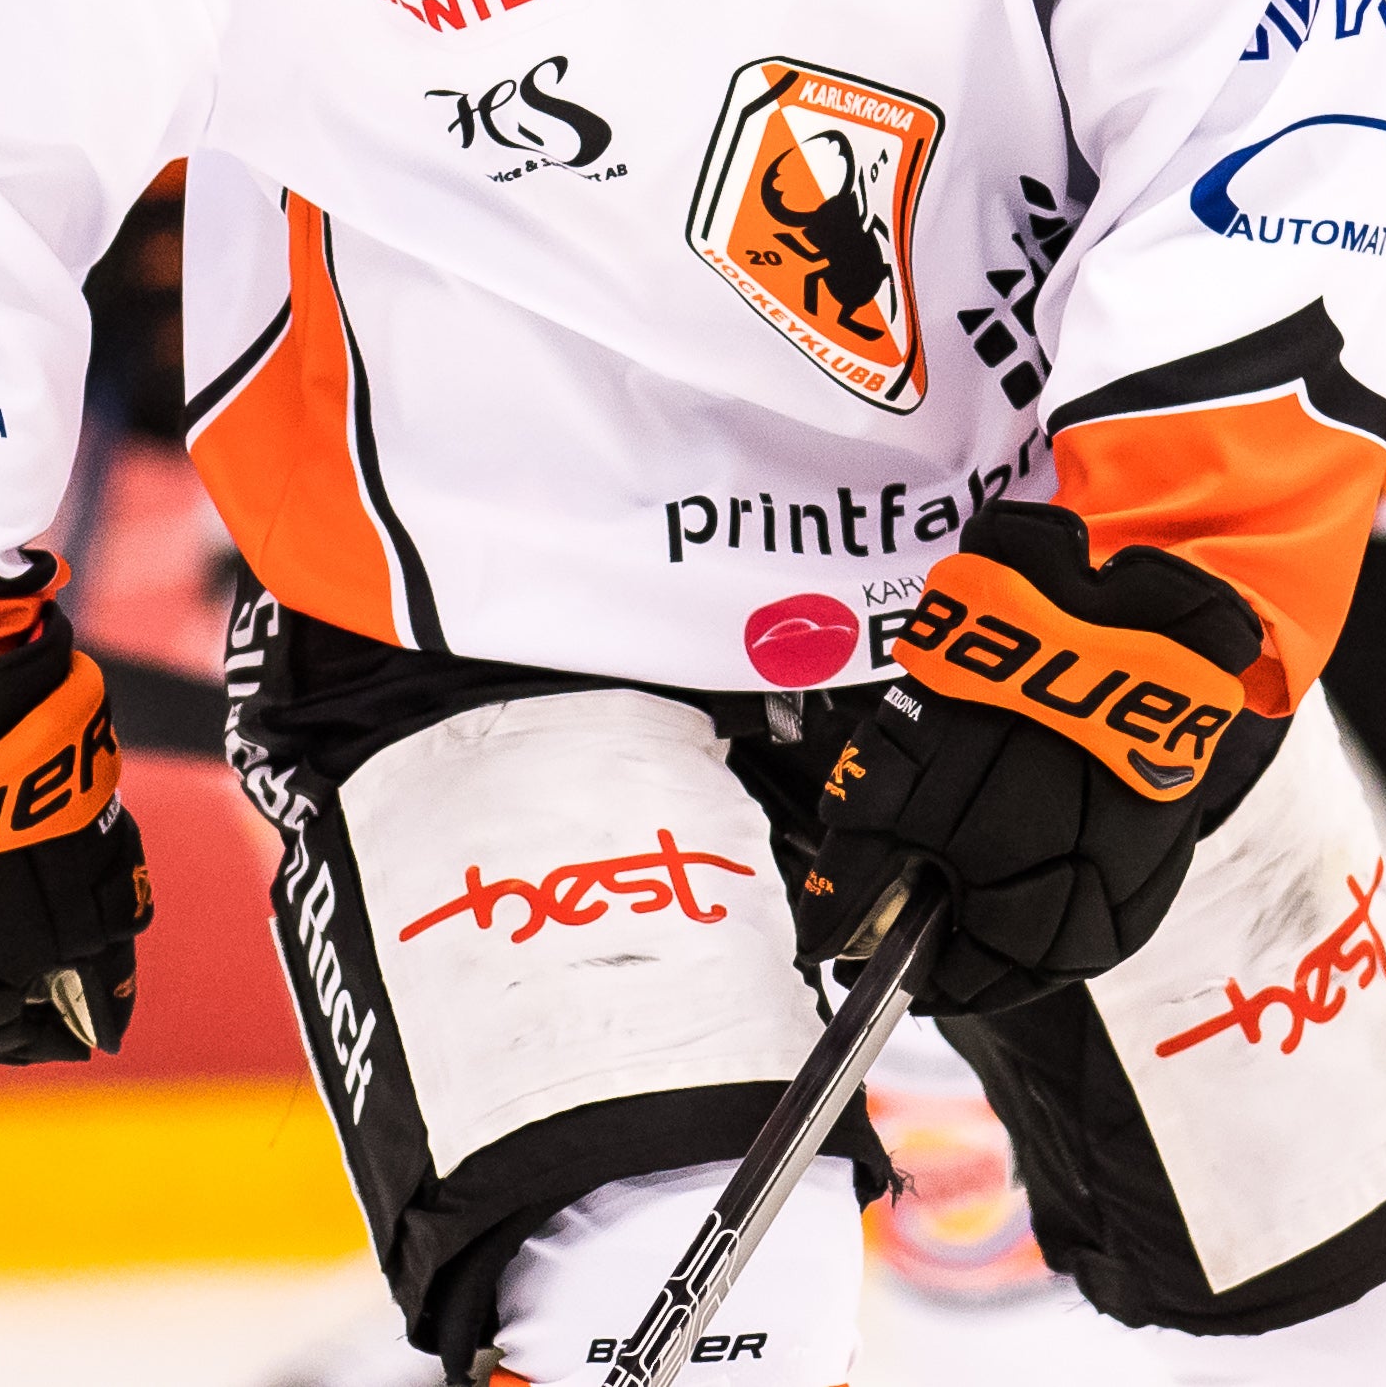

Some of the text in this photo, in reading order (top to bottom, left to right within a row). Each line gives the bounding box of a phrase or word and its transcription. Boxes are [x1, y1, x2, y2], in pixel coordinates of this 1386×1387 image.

[798, 79, 915, 133] KARLSKRONA
[745, 249, 784, 266] 20
[702, 247, 887, 392] HOCKEYKLUBB
[664, 426, 1053, 564] printfabr
[585, 1331, 769, 1364] BER
